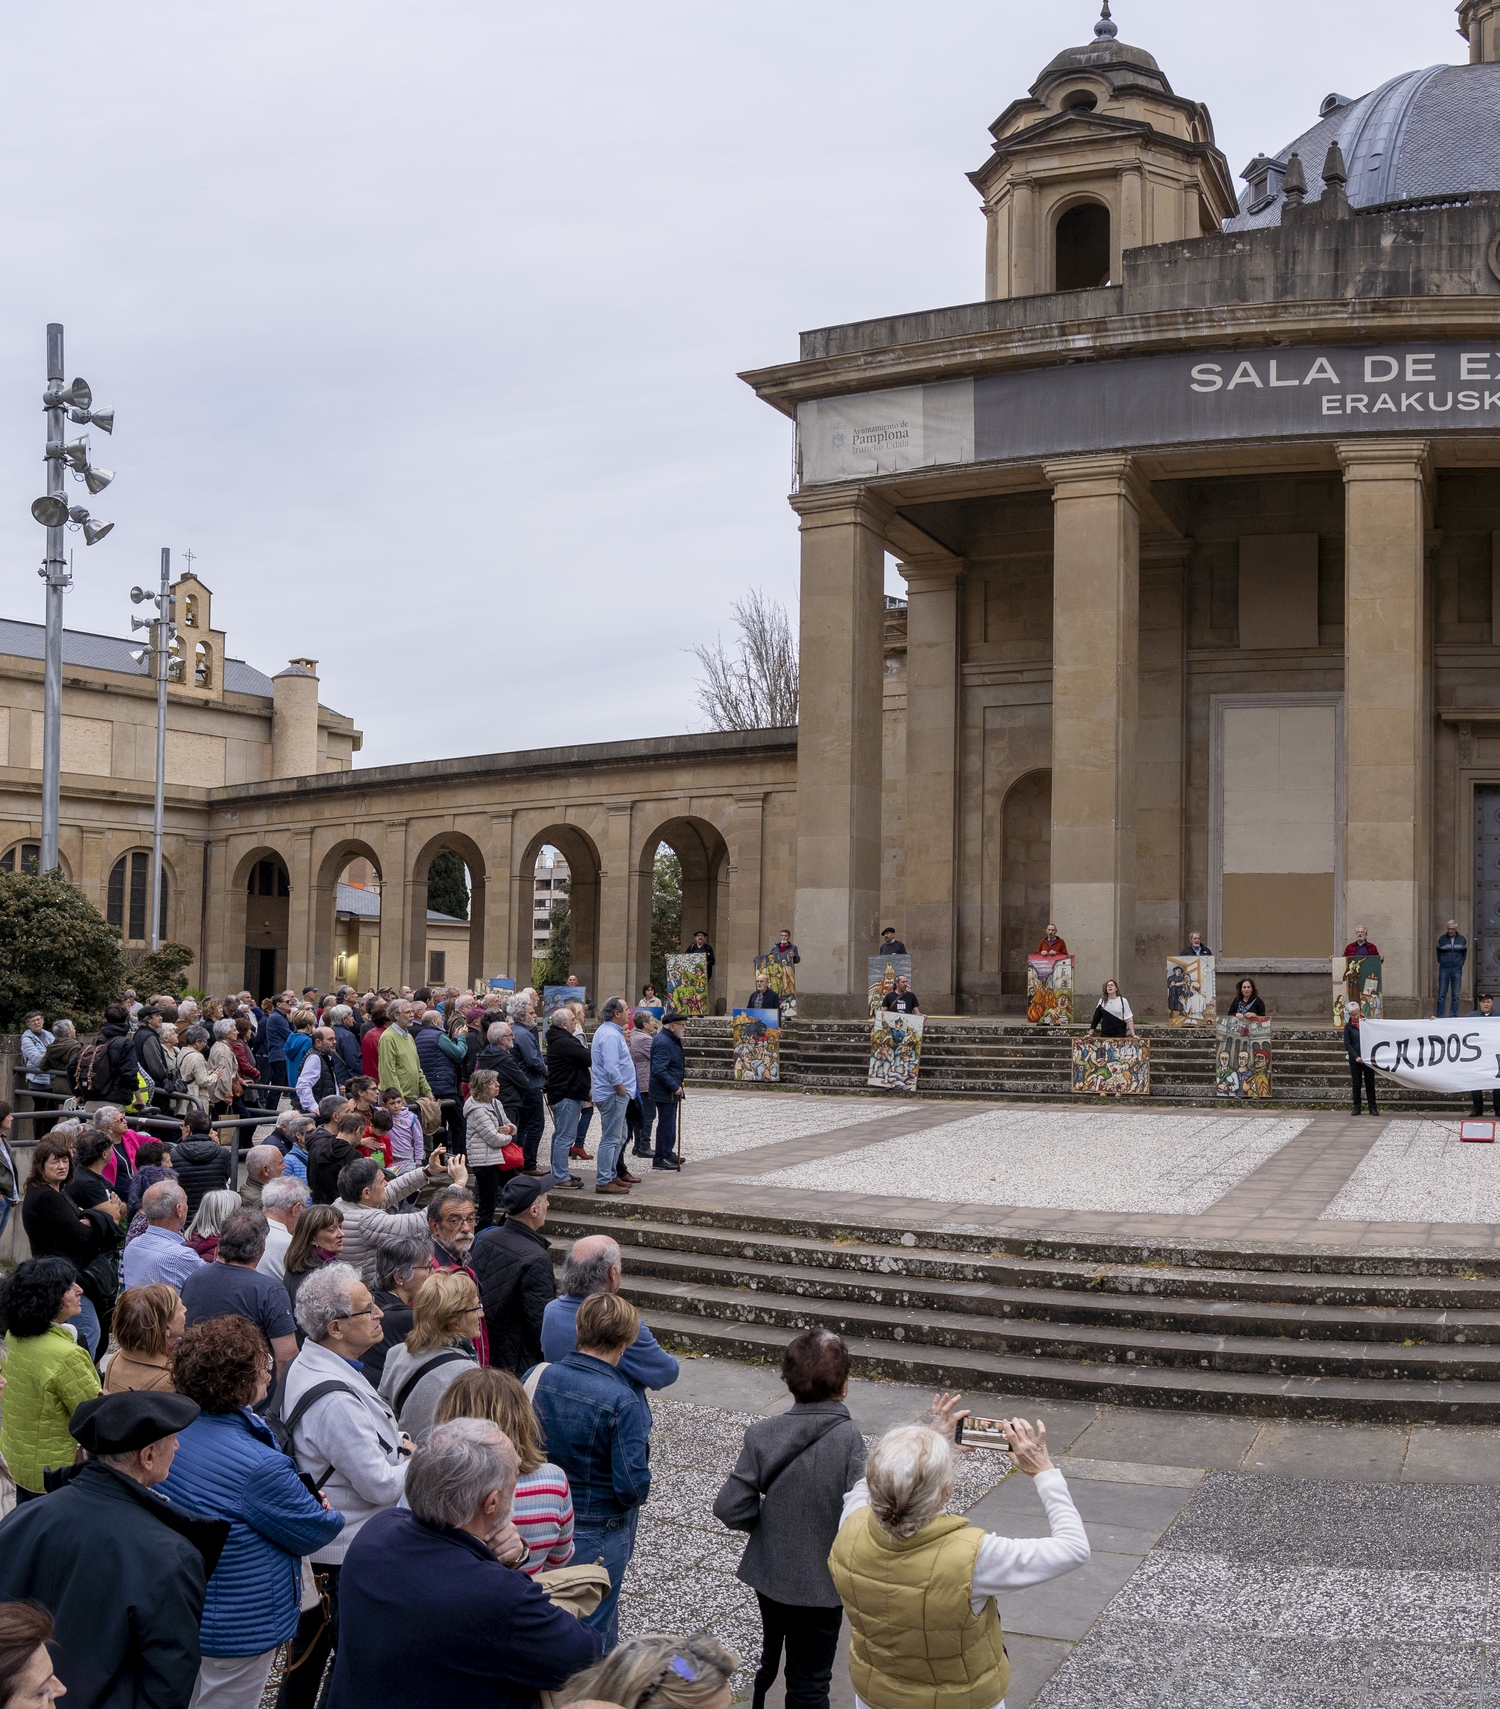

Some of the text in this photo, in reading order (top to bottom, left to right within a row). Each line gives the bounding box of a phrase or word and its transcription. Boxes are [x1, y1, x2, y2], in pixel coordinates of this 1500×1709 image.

[1189, 356, 1340, 393] SALA
[1363, 355, 1437, 383] DE
[852, 420, 909, 435] Ayuntamiento de
[852, 429, 909, 445] Pamplona
[886, 440, 909, 450] Udala
[1370, 1032, 1482, 1072] CAIDOS
